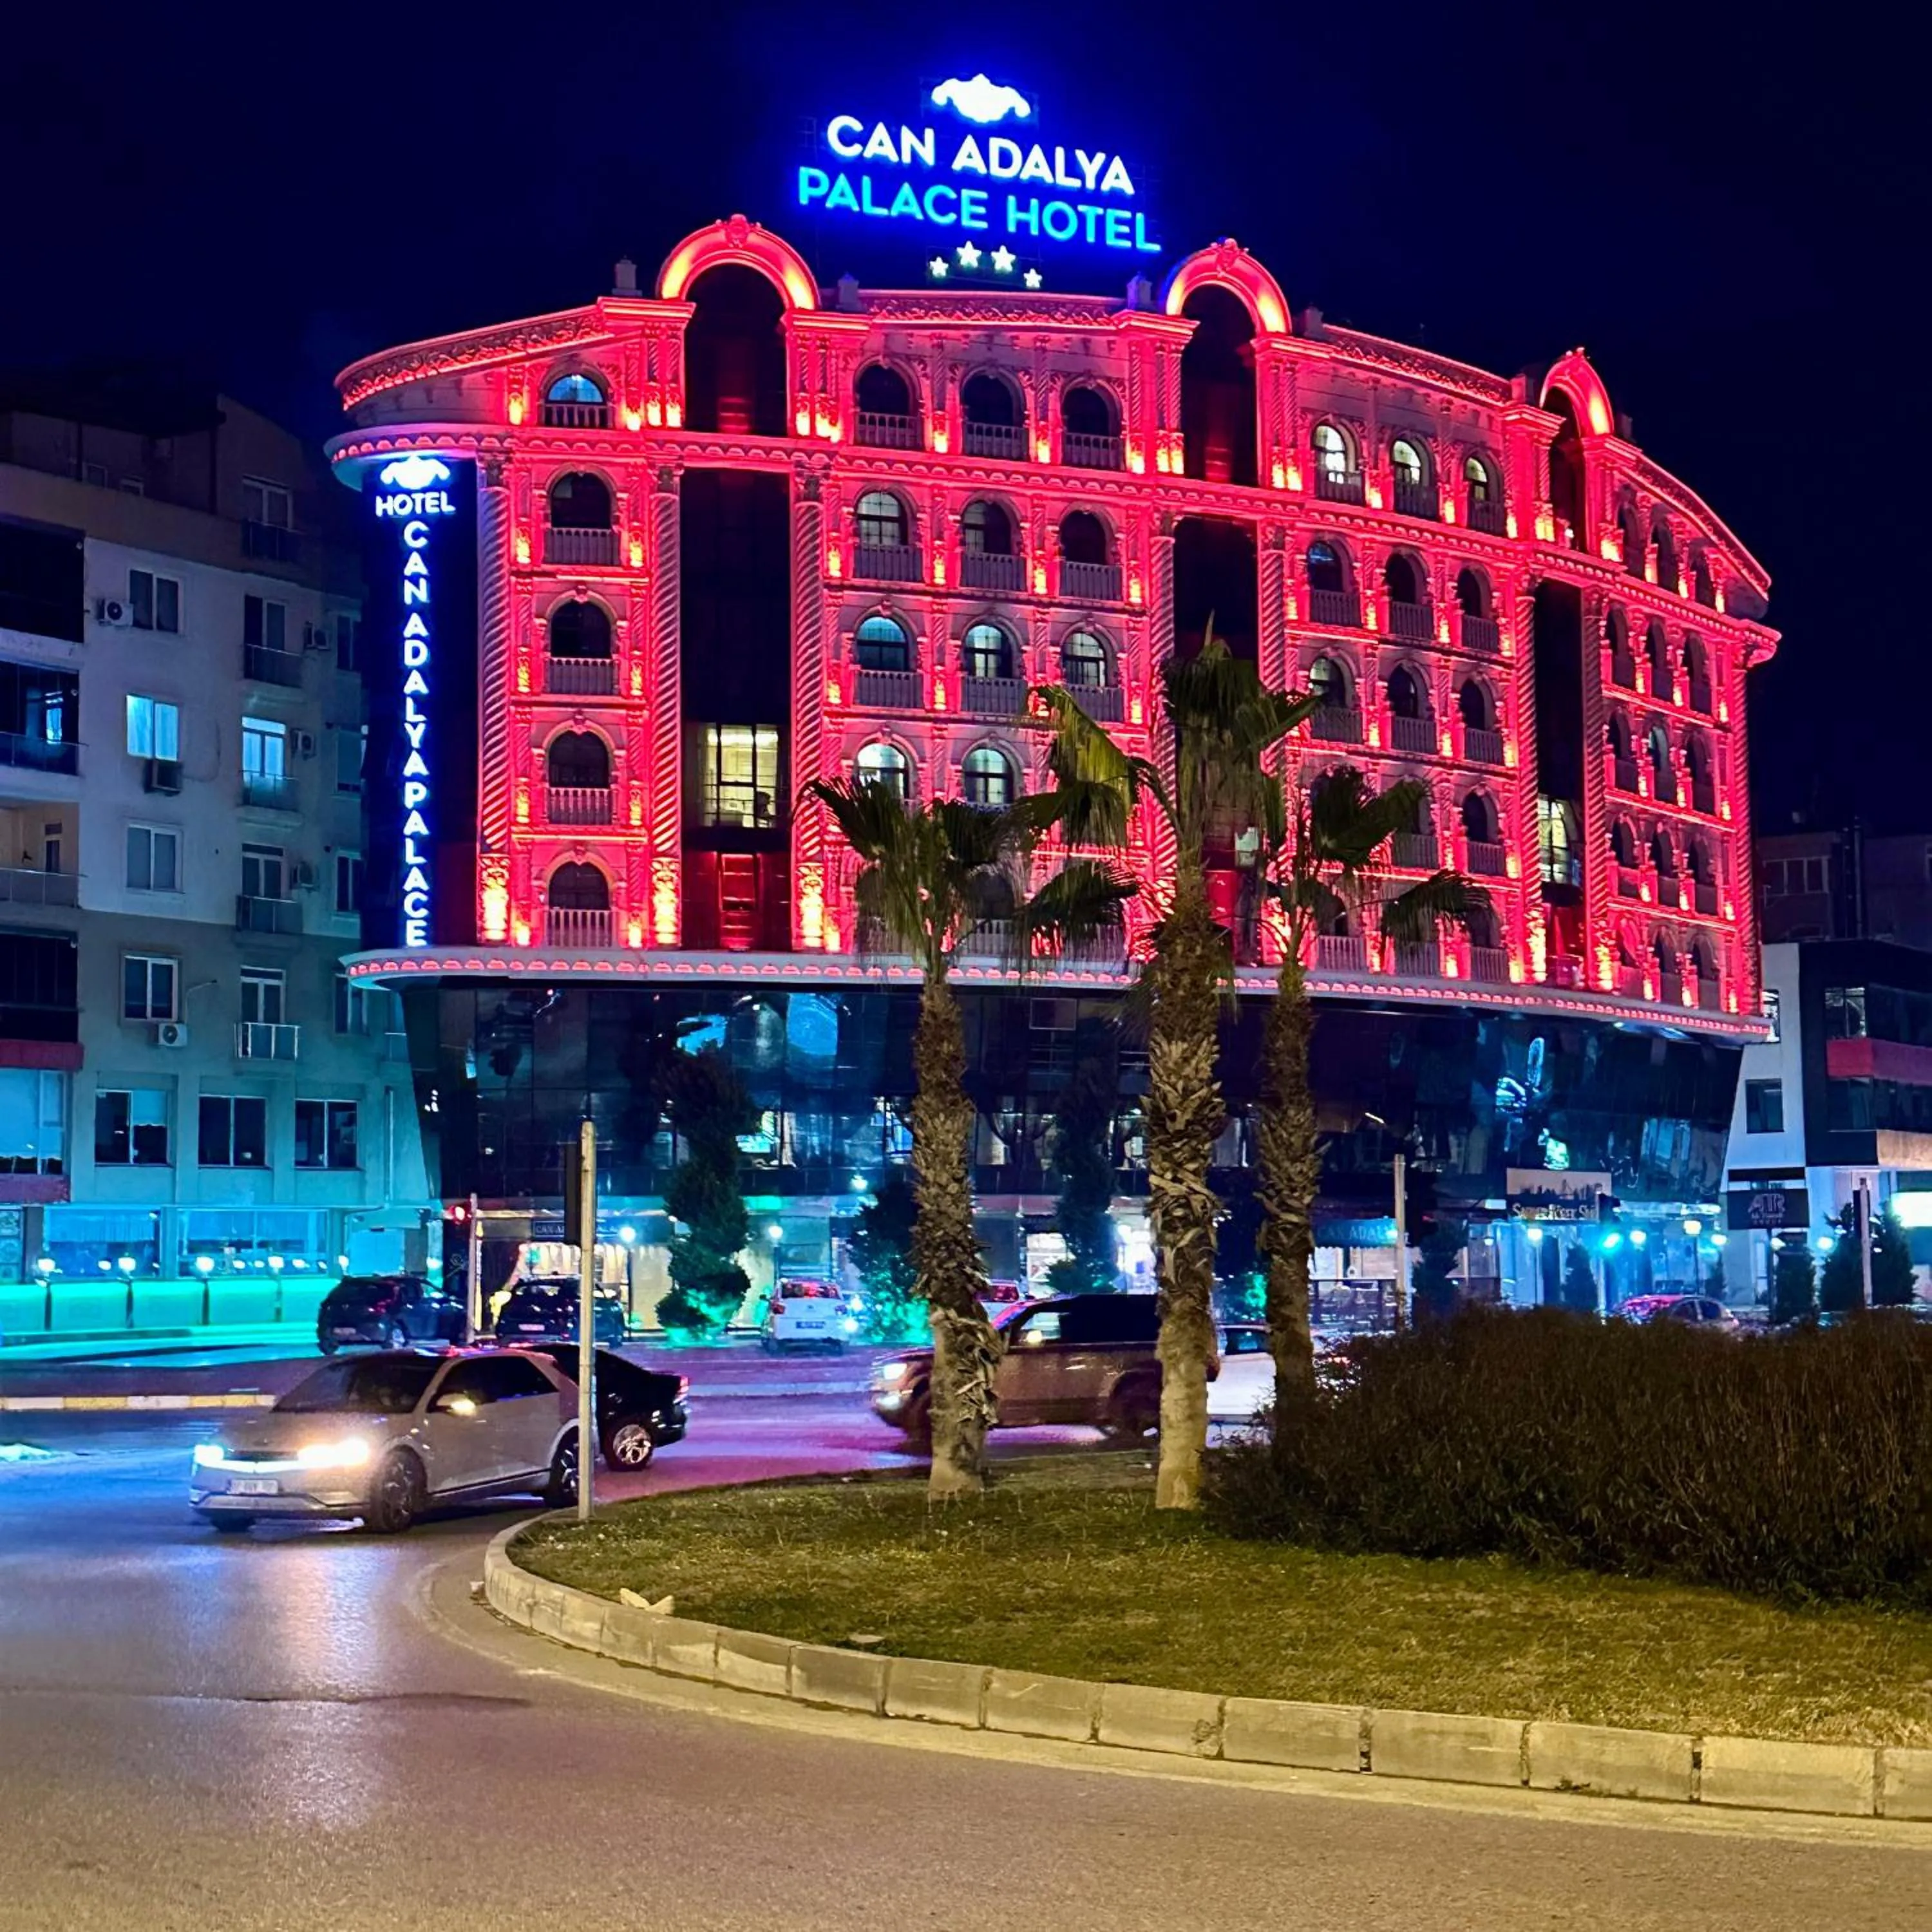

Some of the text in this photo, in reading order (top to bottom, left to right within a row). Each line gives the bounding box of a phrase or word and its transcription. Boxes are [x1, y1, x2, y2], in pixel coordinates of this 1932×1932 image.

[827, 115, 1135, 196] CAN ADALYA
[799, 166, 1162, 252] PALACE HOTEL
[375, 491, 456, 517] HOTEL
[403, 520, 430, 948] CAN ADALYA PALACE
